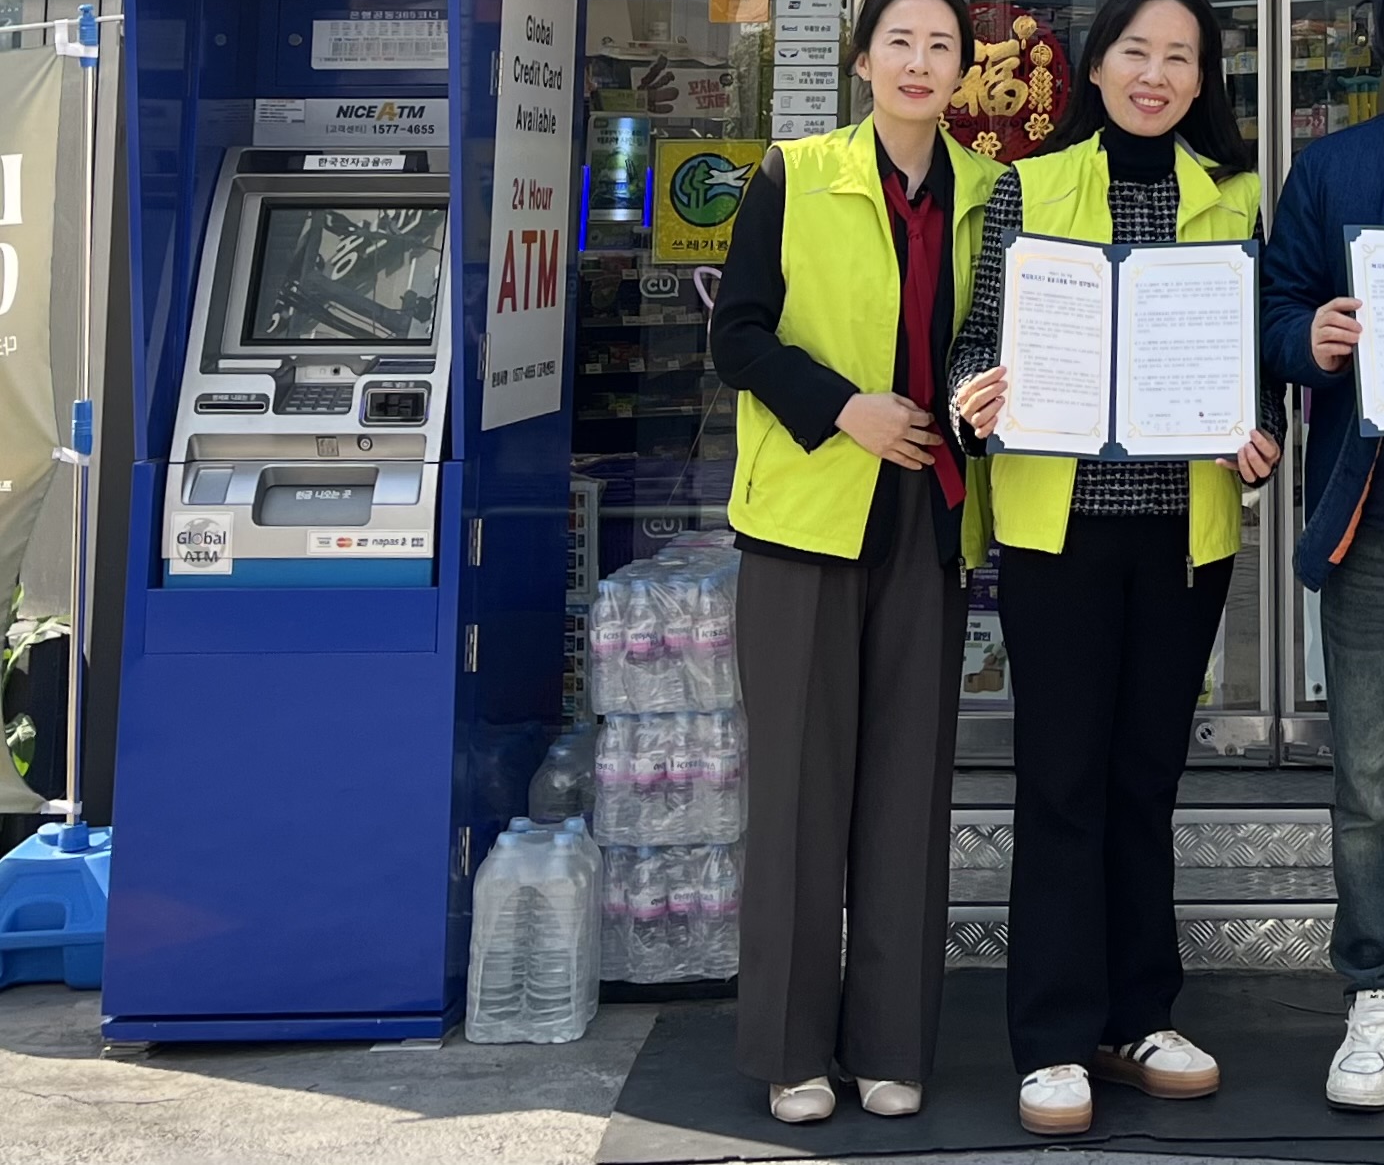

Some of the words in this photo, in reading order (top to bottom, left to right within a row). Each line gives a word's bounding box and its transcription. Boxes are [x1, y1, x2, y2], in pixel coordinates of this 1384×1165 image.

[525, 15, 554, 47] Global
[513, 56, 541, 87] Credit
[542, 61, 563, 91] Card
[515, 103, 557, 135] Available
[371, 124, 436, 135] 1577-4655
[511, 177, 524, 211] 24
[528, 179, 554, 211] Hour
[496, 229, 559, 314] ATM
[645, 277, 672, 293] CU
[315, 489, 341, 500] 나오는
[650, 519, 675, 532] CU
[176, 530, 227, 546] Global
[183, 550, 220, 563] ATM
